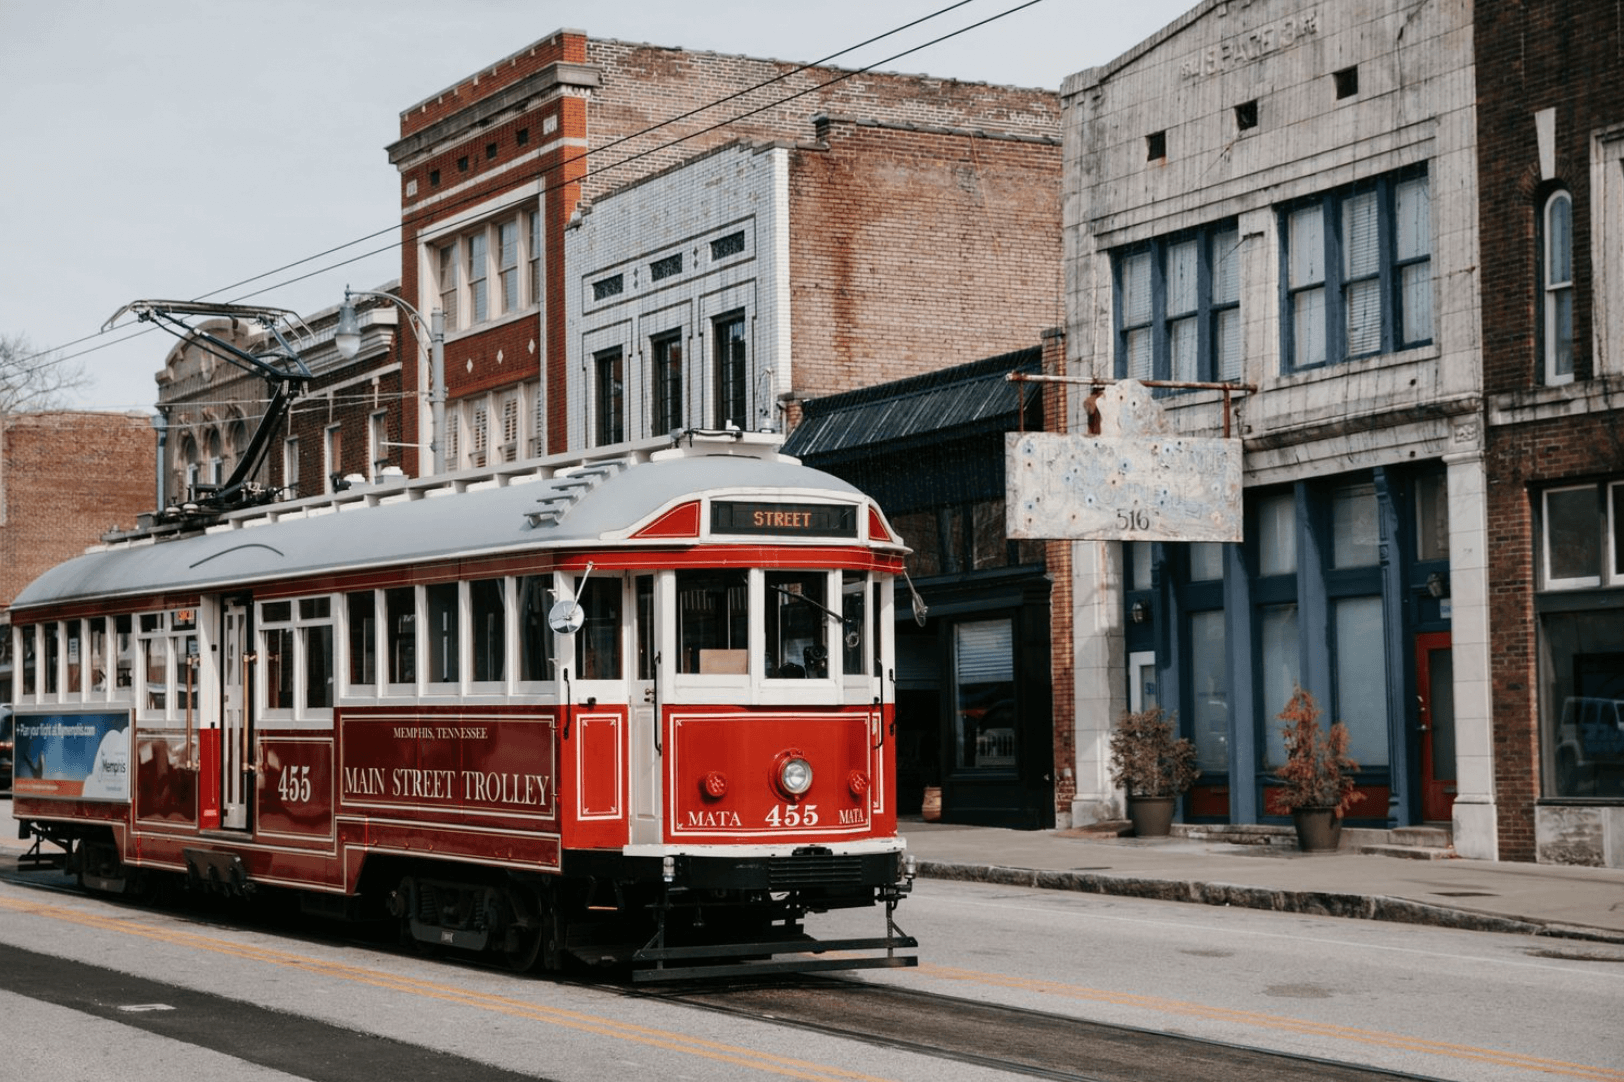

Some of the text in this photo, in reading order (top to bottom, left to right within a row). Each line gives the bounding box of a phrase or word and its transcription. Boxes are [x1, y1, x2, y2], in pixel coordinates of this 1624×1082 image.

[753, 511, 812, 528] STREET
[1116, 508, 1150, 531] 516
[393, 727, 488, 740] MEMPHIS, TENNESSEE
[102, 758, 126, 776] Memphis
[278, 765, 311, 803] 455
[344, 766, 550, 806] MAIN STREET TROLLEY
[688, 810, 742, 827] MATA
[765, 804, 819, 827] 455
[839, 808, 864, 825] MATA
